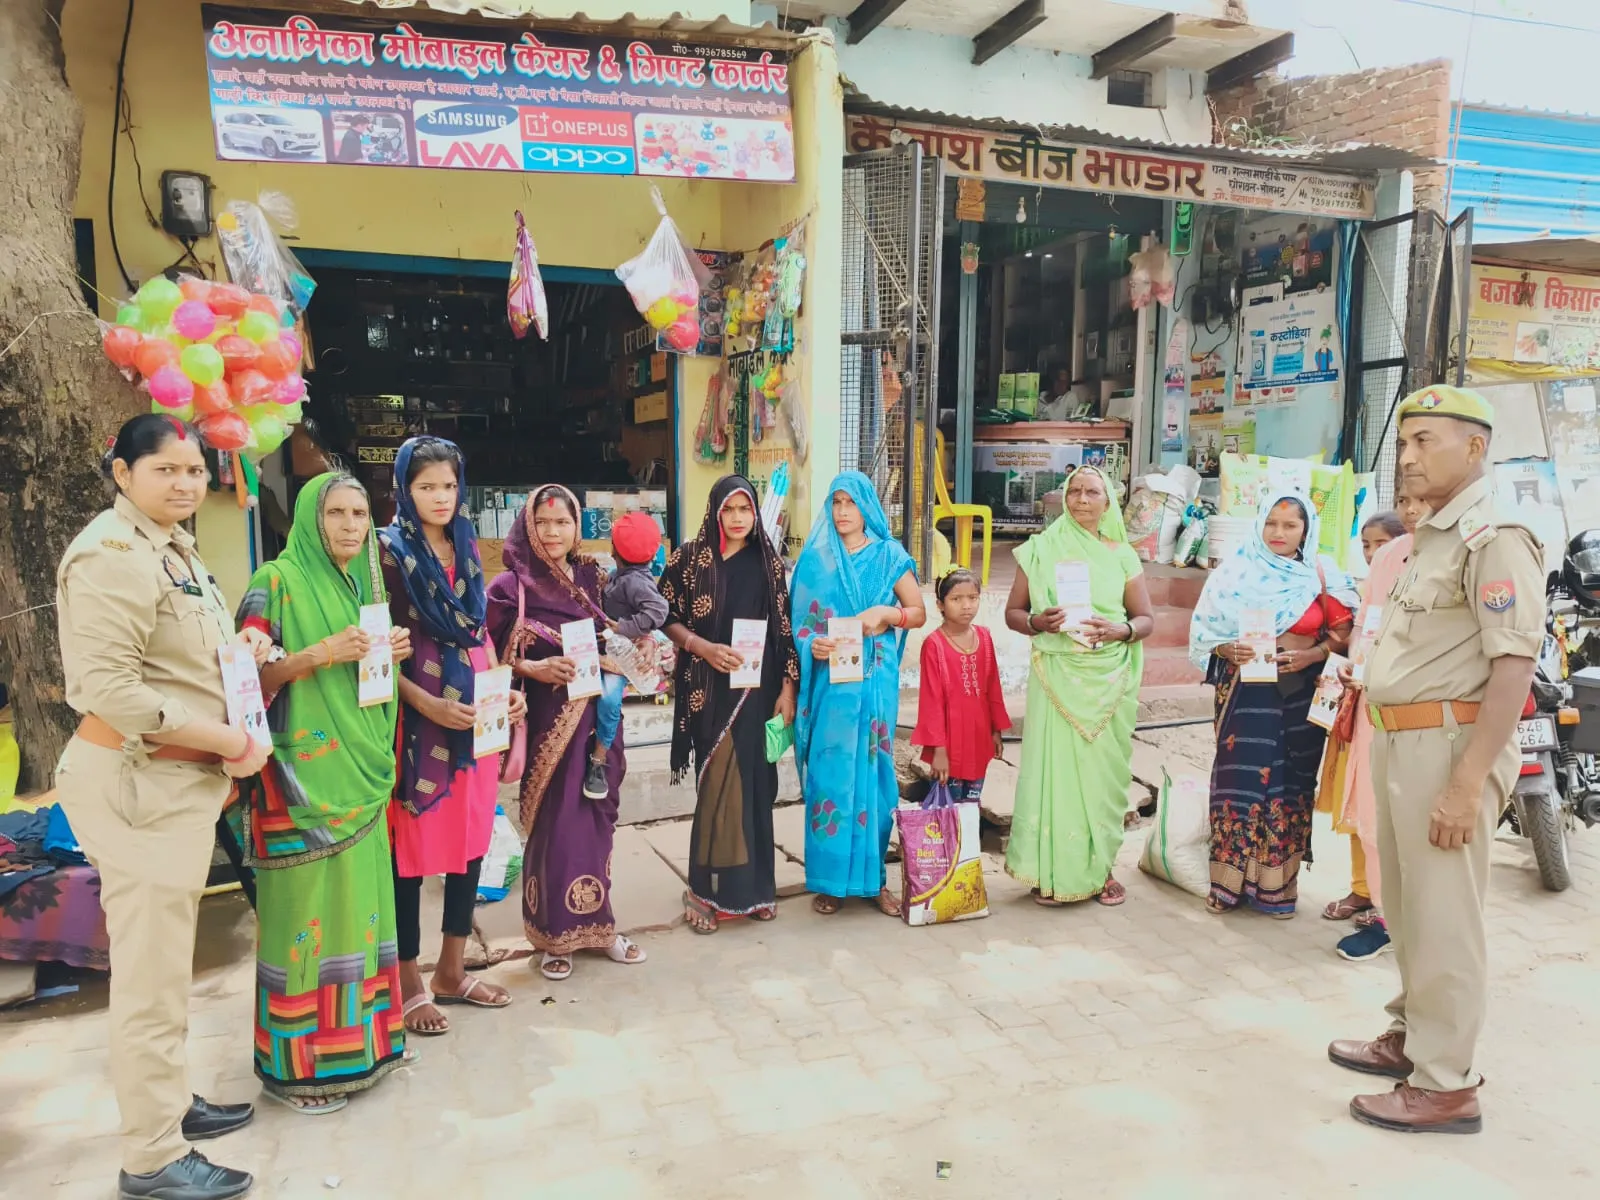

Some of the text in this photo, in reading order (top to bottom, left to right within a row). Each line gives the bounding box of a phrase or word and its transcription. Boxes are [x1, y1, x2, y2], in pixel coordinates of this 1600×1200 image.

[209, 15, 788, 94] अनामिका मोबाइल केयर & गिफ्ट कार्नर
[694, 47, 747, 59] 9936785569
[427, 111, 507, 127] SAMSUNG
[552, 120, 628, 137] ONEPLUS
[419, 140, 520, 169] LAVA
[527, 147, 627, 168] oppo
[990, 133, 1078, 181] बीज
[1082, 150, 1205, 198] भण्डार
[1270, 326, 1311, 344] कस्टोडिया
[589, 513, 598, 538] vivo
